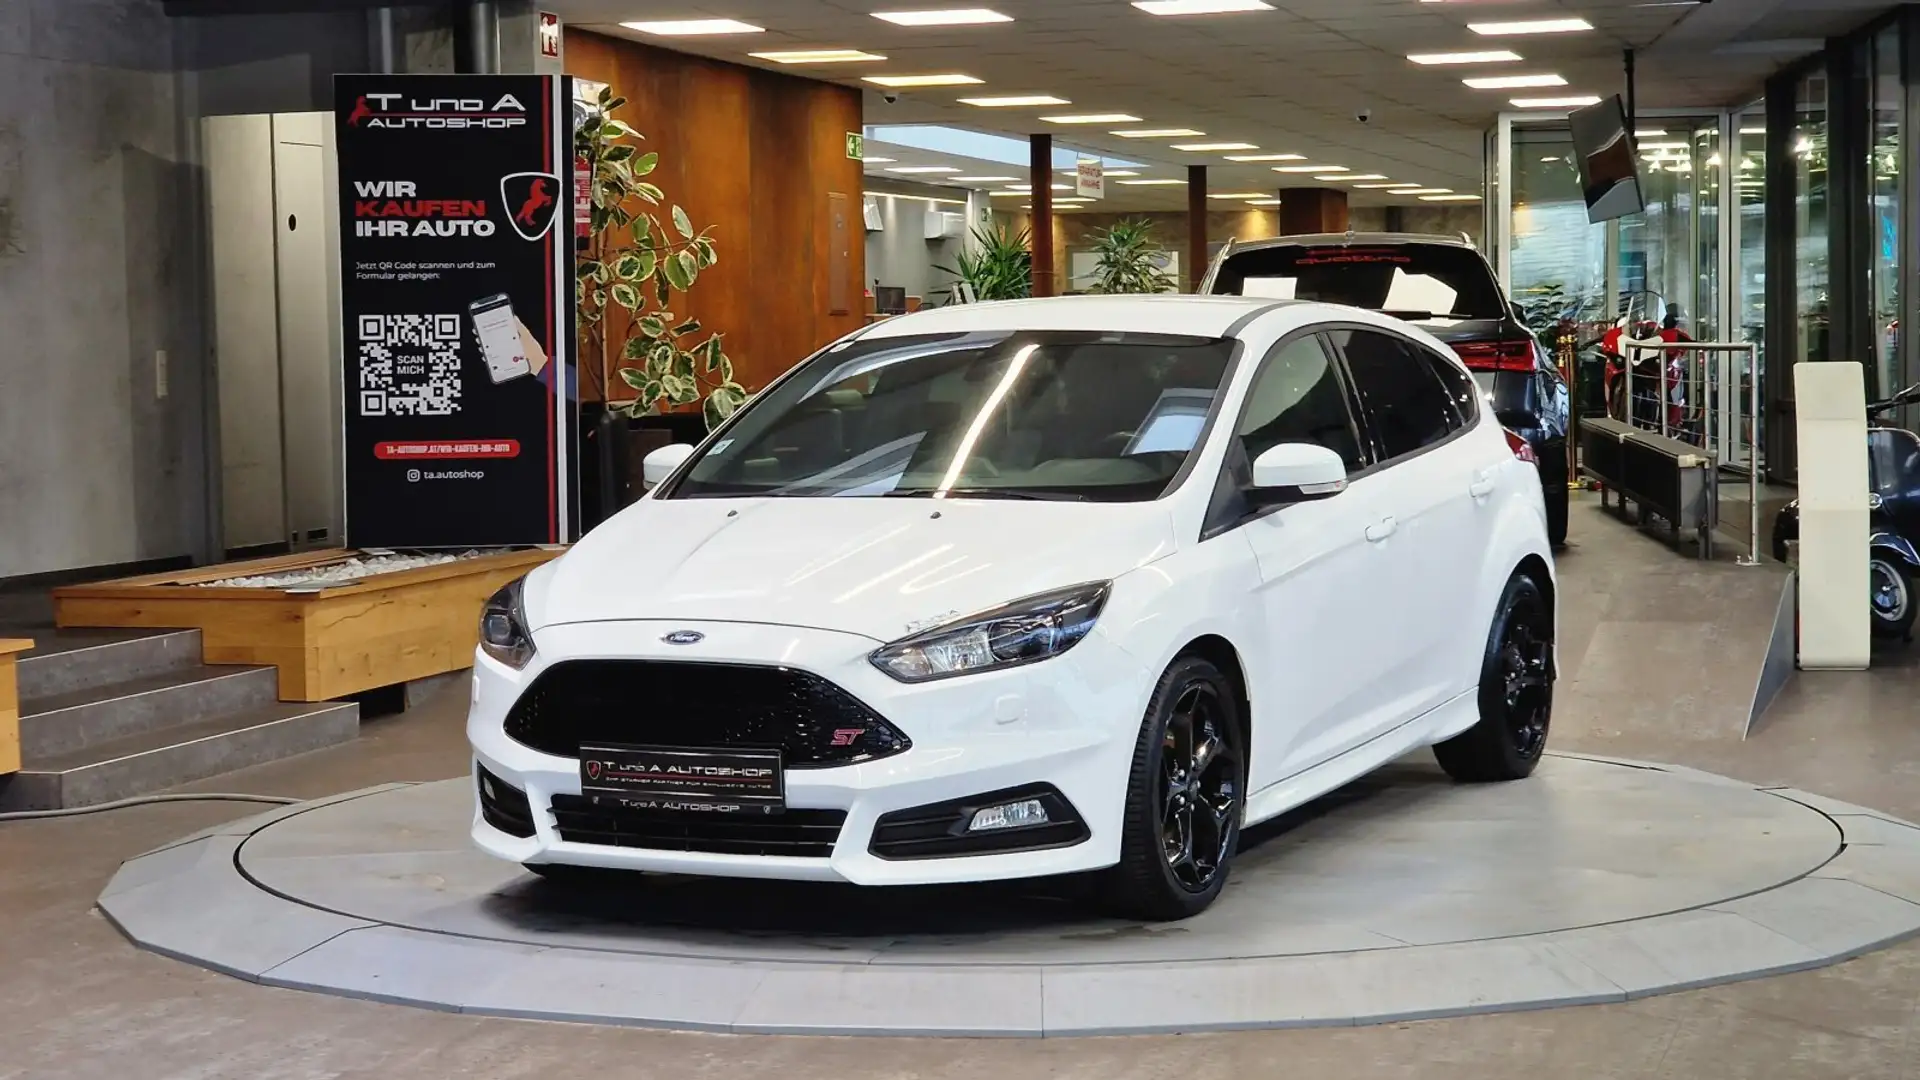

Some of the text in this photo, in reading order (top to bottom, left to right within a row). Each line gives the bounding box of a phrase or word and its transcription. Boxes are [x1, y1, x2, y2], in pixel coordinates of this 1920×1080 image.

[366, 93, 402, 111] T
[491, 93, 526, 112] A
[367, 118, 527, 128] AUTOSHOP
[354, 181, 416, 197] WIR
[355, 200, 486, 216] KAUFEN
[355, 220, 496, 237] IHR AUTO
[356, 261, 377, 270] Jetzt
[379, 261, 393, 270] QR
[394, 261, 417, 269] Code
[457, 261, 474, 269] und
[1295, 254, 1411, 265] quattro
[356, 272, 440, 281] Formular gelangen:
[397, 355, 424, 364] SCAN
[397, 365, 424, 375] MICH
[423, 469, 485, 480] ta.autoshop
[830, 728, 866, 745] ST
[603, 761, 616, 769] T
[649, 764, 662, 773] A
[666, 766, 772, 777] AUTOSHOP
[619, 799, 629, 807] T
[662, 801, 741, 812] AUTOSHOP
